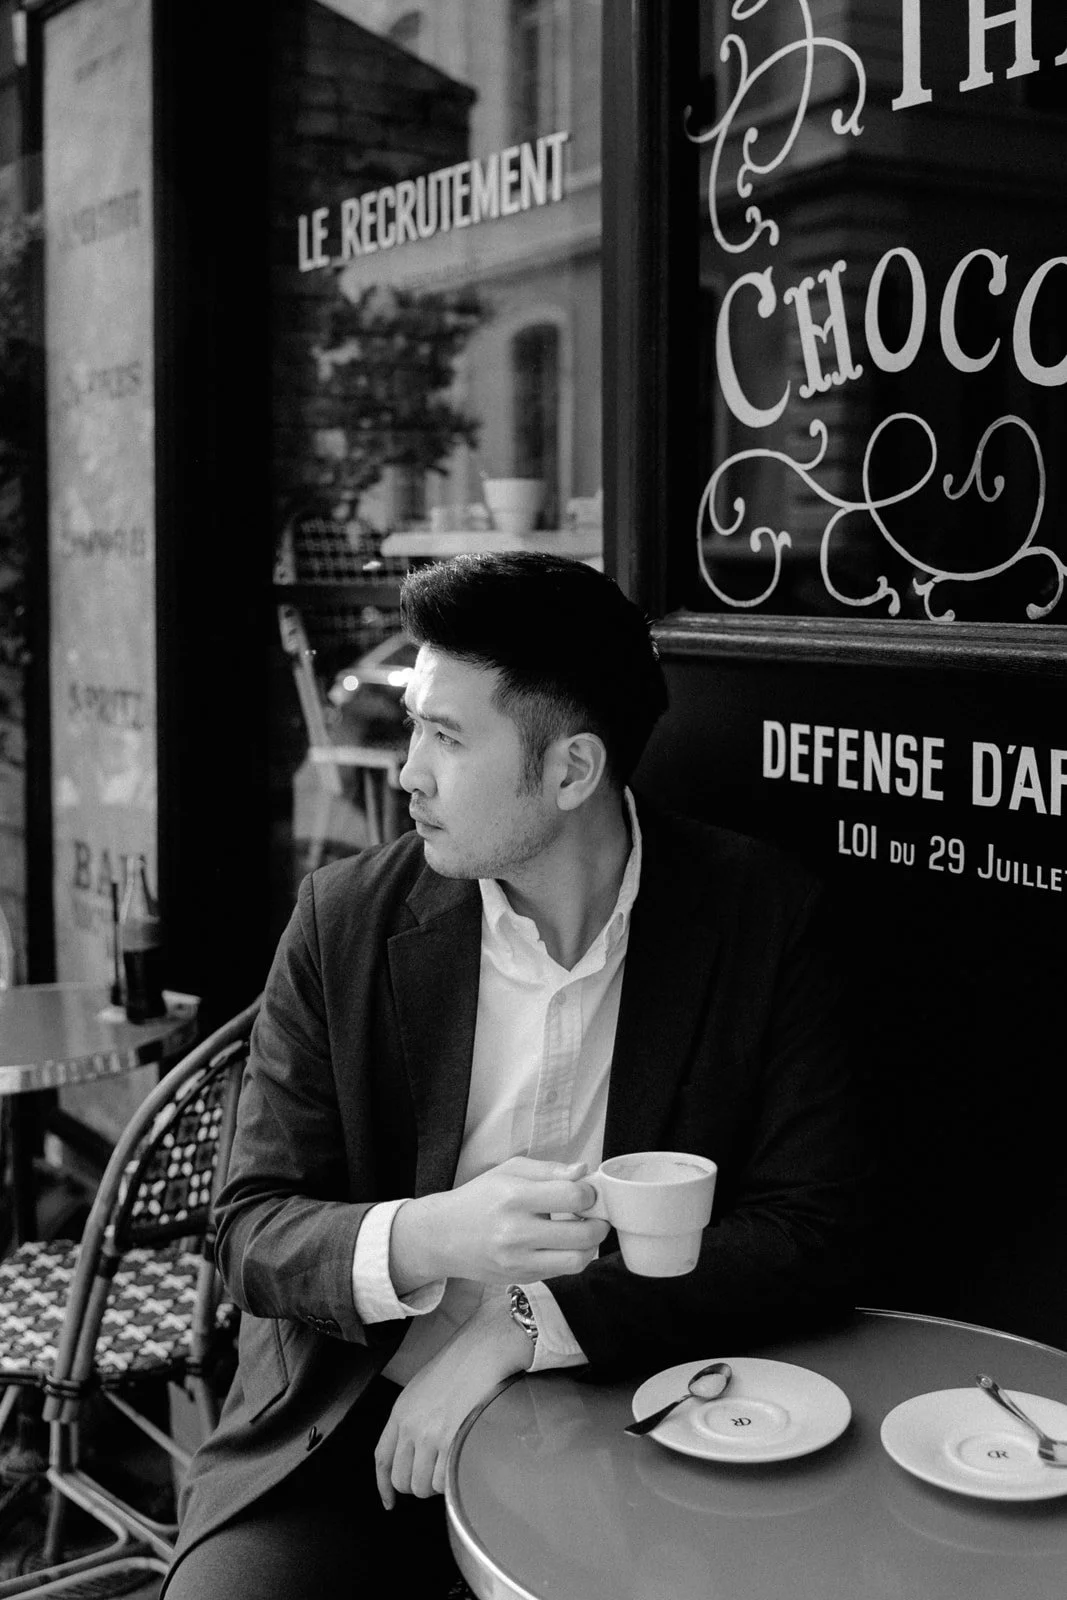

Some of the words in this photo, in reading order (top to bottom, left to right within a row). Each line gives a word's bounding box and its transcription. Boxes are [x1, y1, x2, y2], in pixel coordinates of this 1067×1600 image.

[891, 0, 1067, 111] TH
[299, 207, 330, 272] LE
[341, 131, 569, 261] RECRUTEMENT
[763, 720, 944, 801] DEFENSE
[839, 820, 876, 859] LOI
[929, 836, 964, 873] 29
[978, 844, 1067, 891] JUILLE
